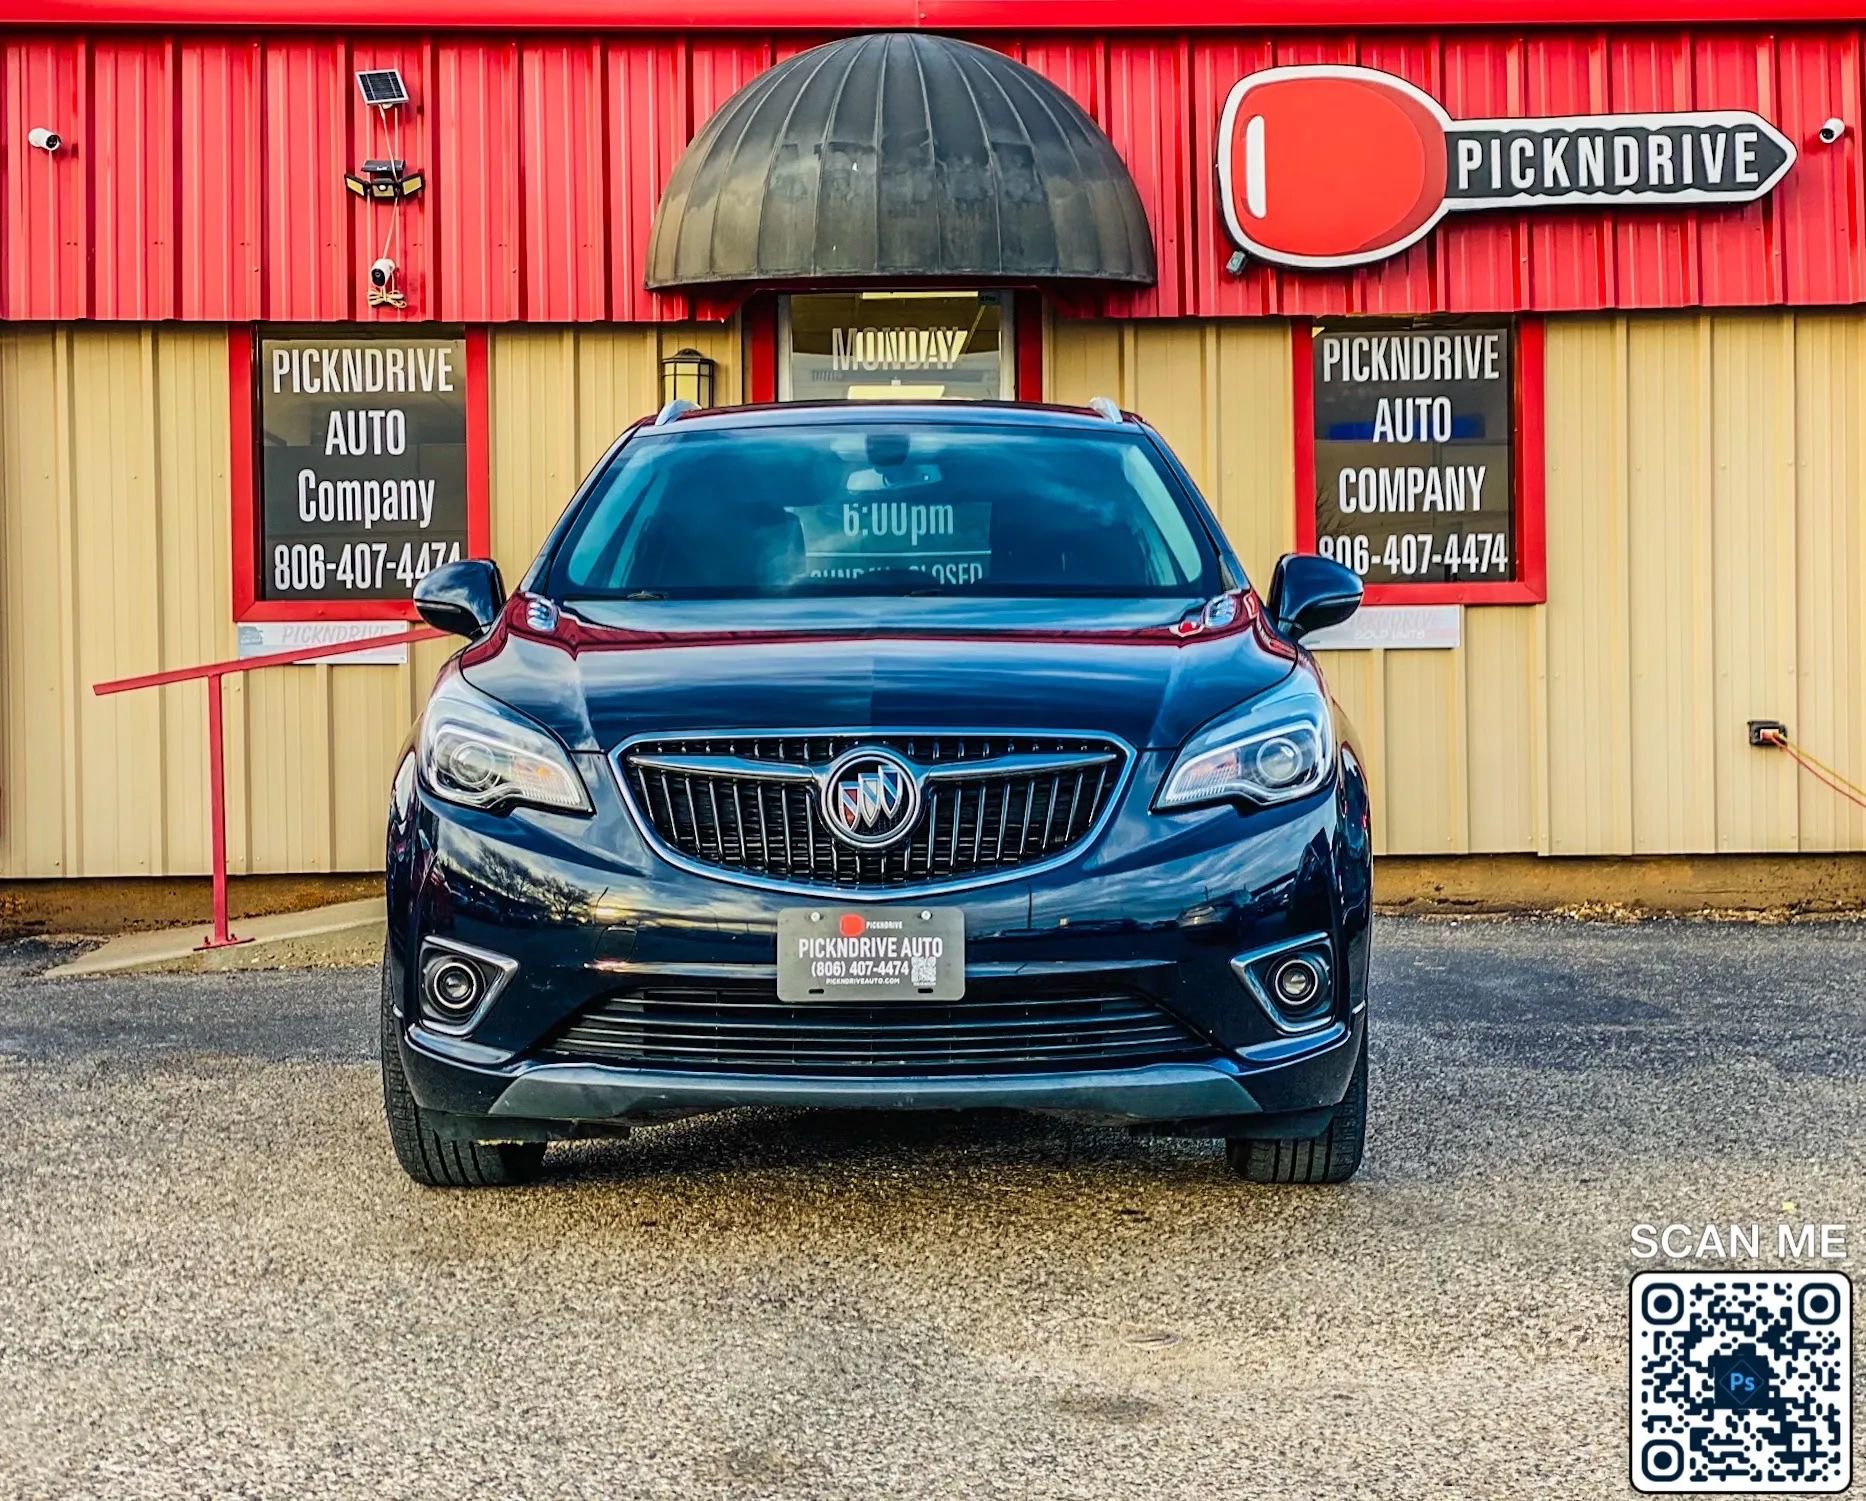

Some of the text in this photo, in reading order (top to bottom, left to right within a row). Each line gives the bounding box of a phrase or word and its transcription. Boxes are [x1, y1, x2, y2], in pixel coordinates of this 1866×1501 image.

[1457, 131, 1760, 191] PICKNDRIVE
[272, 348, 455, 394] PICKNDRIVE
[832, 325, 958, 371] MONDAY
[1322, 334, 1500, 383] PICKNDRIVE
[324, 409, 406, 456] AUTO
[1372, 395, 1452, 444] AUTO
[298, 468, 436, 530] Company
[1338, 465, 1487, 515] COMPANY
[842, 501, 954, 546] 6:00pm
[1318, 532, 1509, 577] 806-407-4474
[799, 937, 943, 959] PICKNDRIVE AUTO
[811, 960, 909, 977] (806) 407-4474
[825, 977, 900, 985] PICKNDRIVEAUTO.COM
